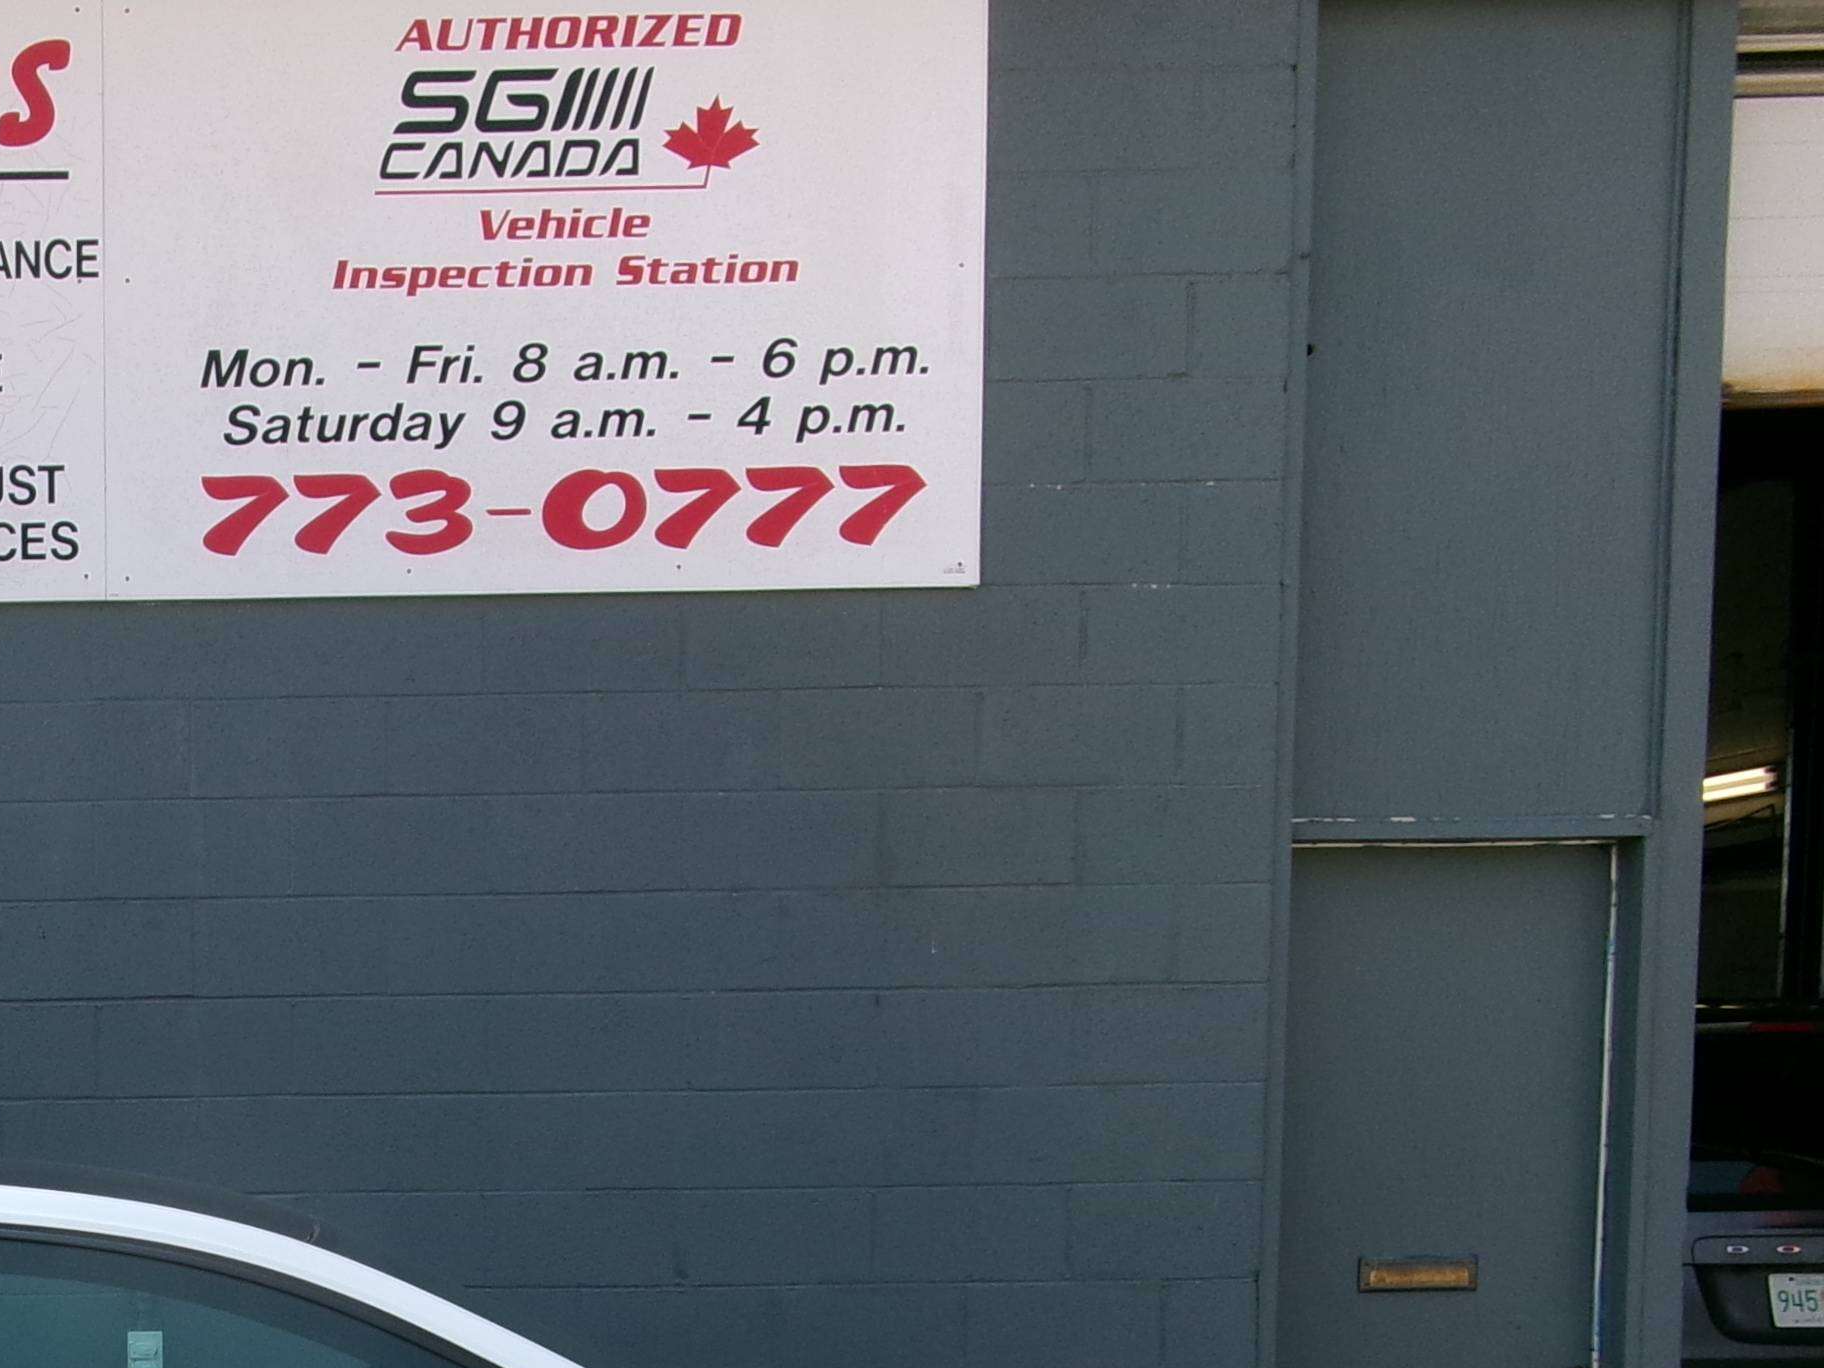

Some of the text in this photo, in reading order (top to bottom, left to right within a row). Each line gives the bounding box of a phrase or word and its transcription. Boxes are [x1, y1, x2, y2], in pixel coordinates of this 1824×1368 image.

[395, 13, 743, 53] AUTHORIZED
[379, 138, 640, 180] CANADA
[480, 208, 652, 241] Vehicle
[334, 256, 799, 298] Inspection Station
[200, 348, 325, 389] Mon.
[406, 344, 483, 384] Fri.
[512, 342, 548, 383] 8
[573, 351, 679, 382] a.m.
[762, 337, 798, 379] 6
[819, 346, 929, 386] p.m.
[223, 402, 466, 450] Saturday
[490, 400, 526, 441] 9
[550, 408, 656, 440] a.m.
[736, 396, 771, 435] 4
[795, 403, 905, 444] p.m.
[201, 464, 927, 557] 773-0777
[1777, 1289, 1819, 1313] 945
